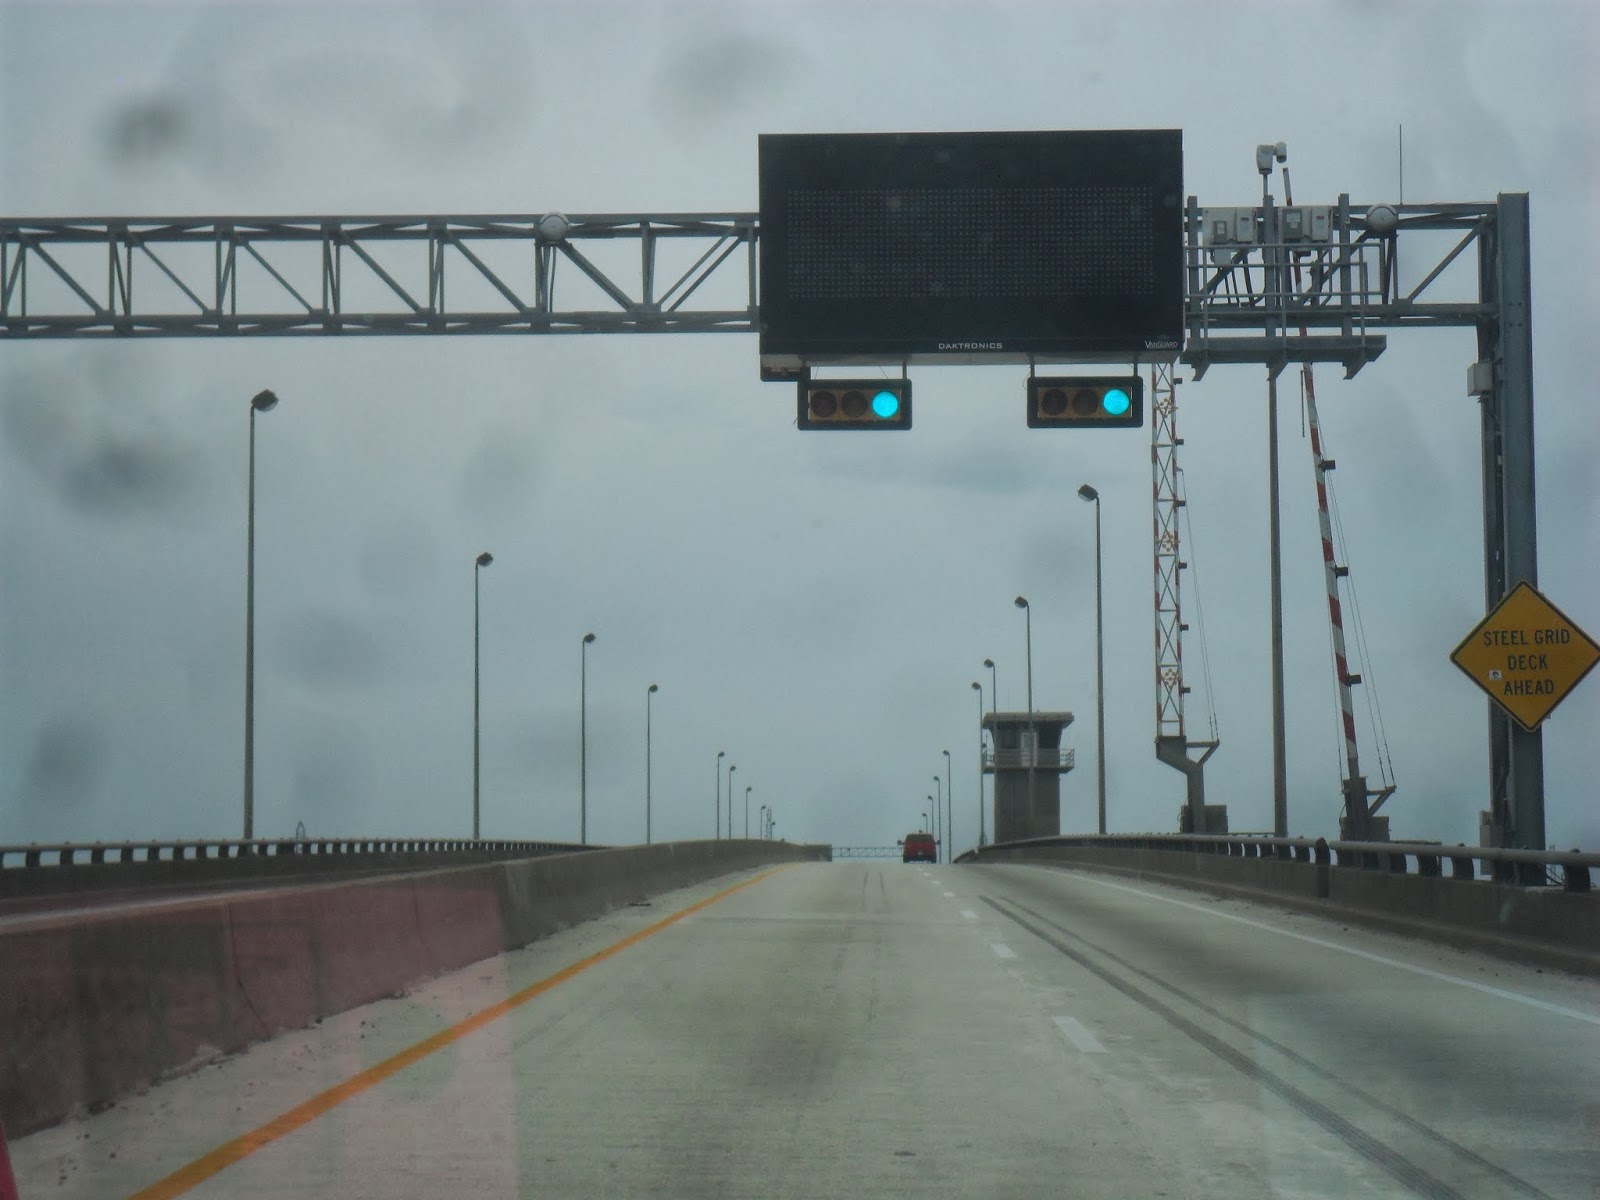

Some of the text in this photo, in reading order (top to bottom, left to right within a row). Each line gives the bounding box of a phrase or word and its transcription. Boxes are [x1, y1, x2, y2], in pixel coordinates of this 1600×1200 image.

[938, 342, 1003, 350] DAKTRONICS
[1483, 629, 1570, 647] STEEL GRID
[1507, 654, 1548, 671] DECK
[1503, 679, 1555, 696] AHEAD
